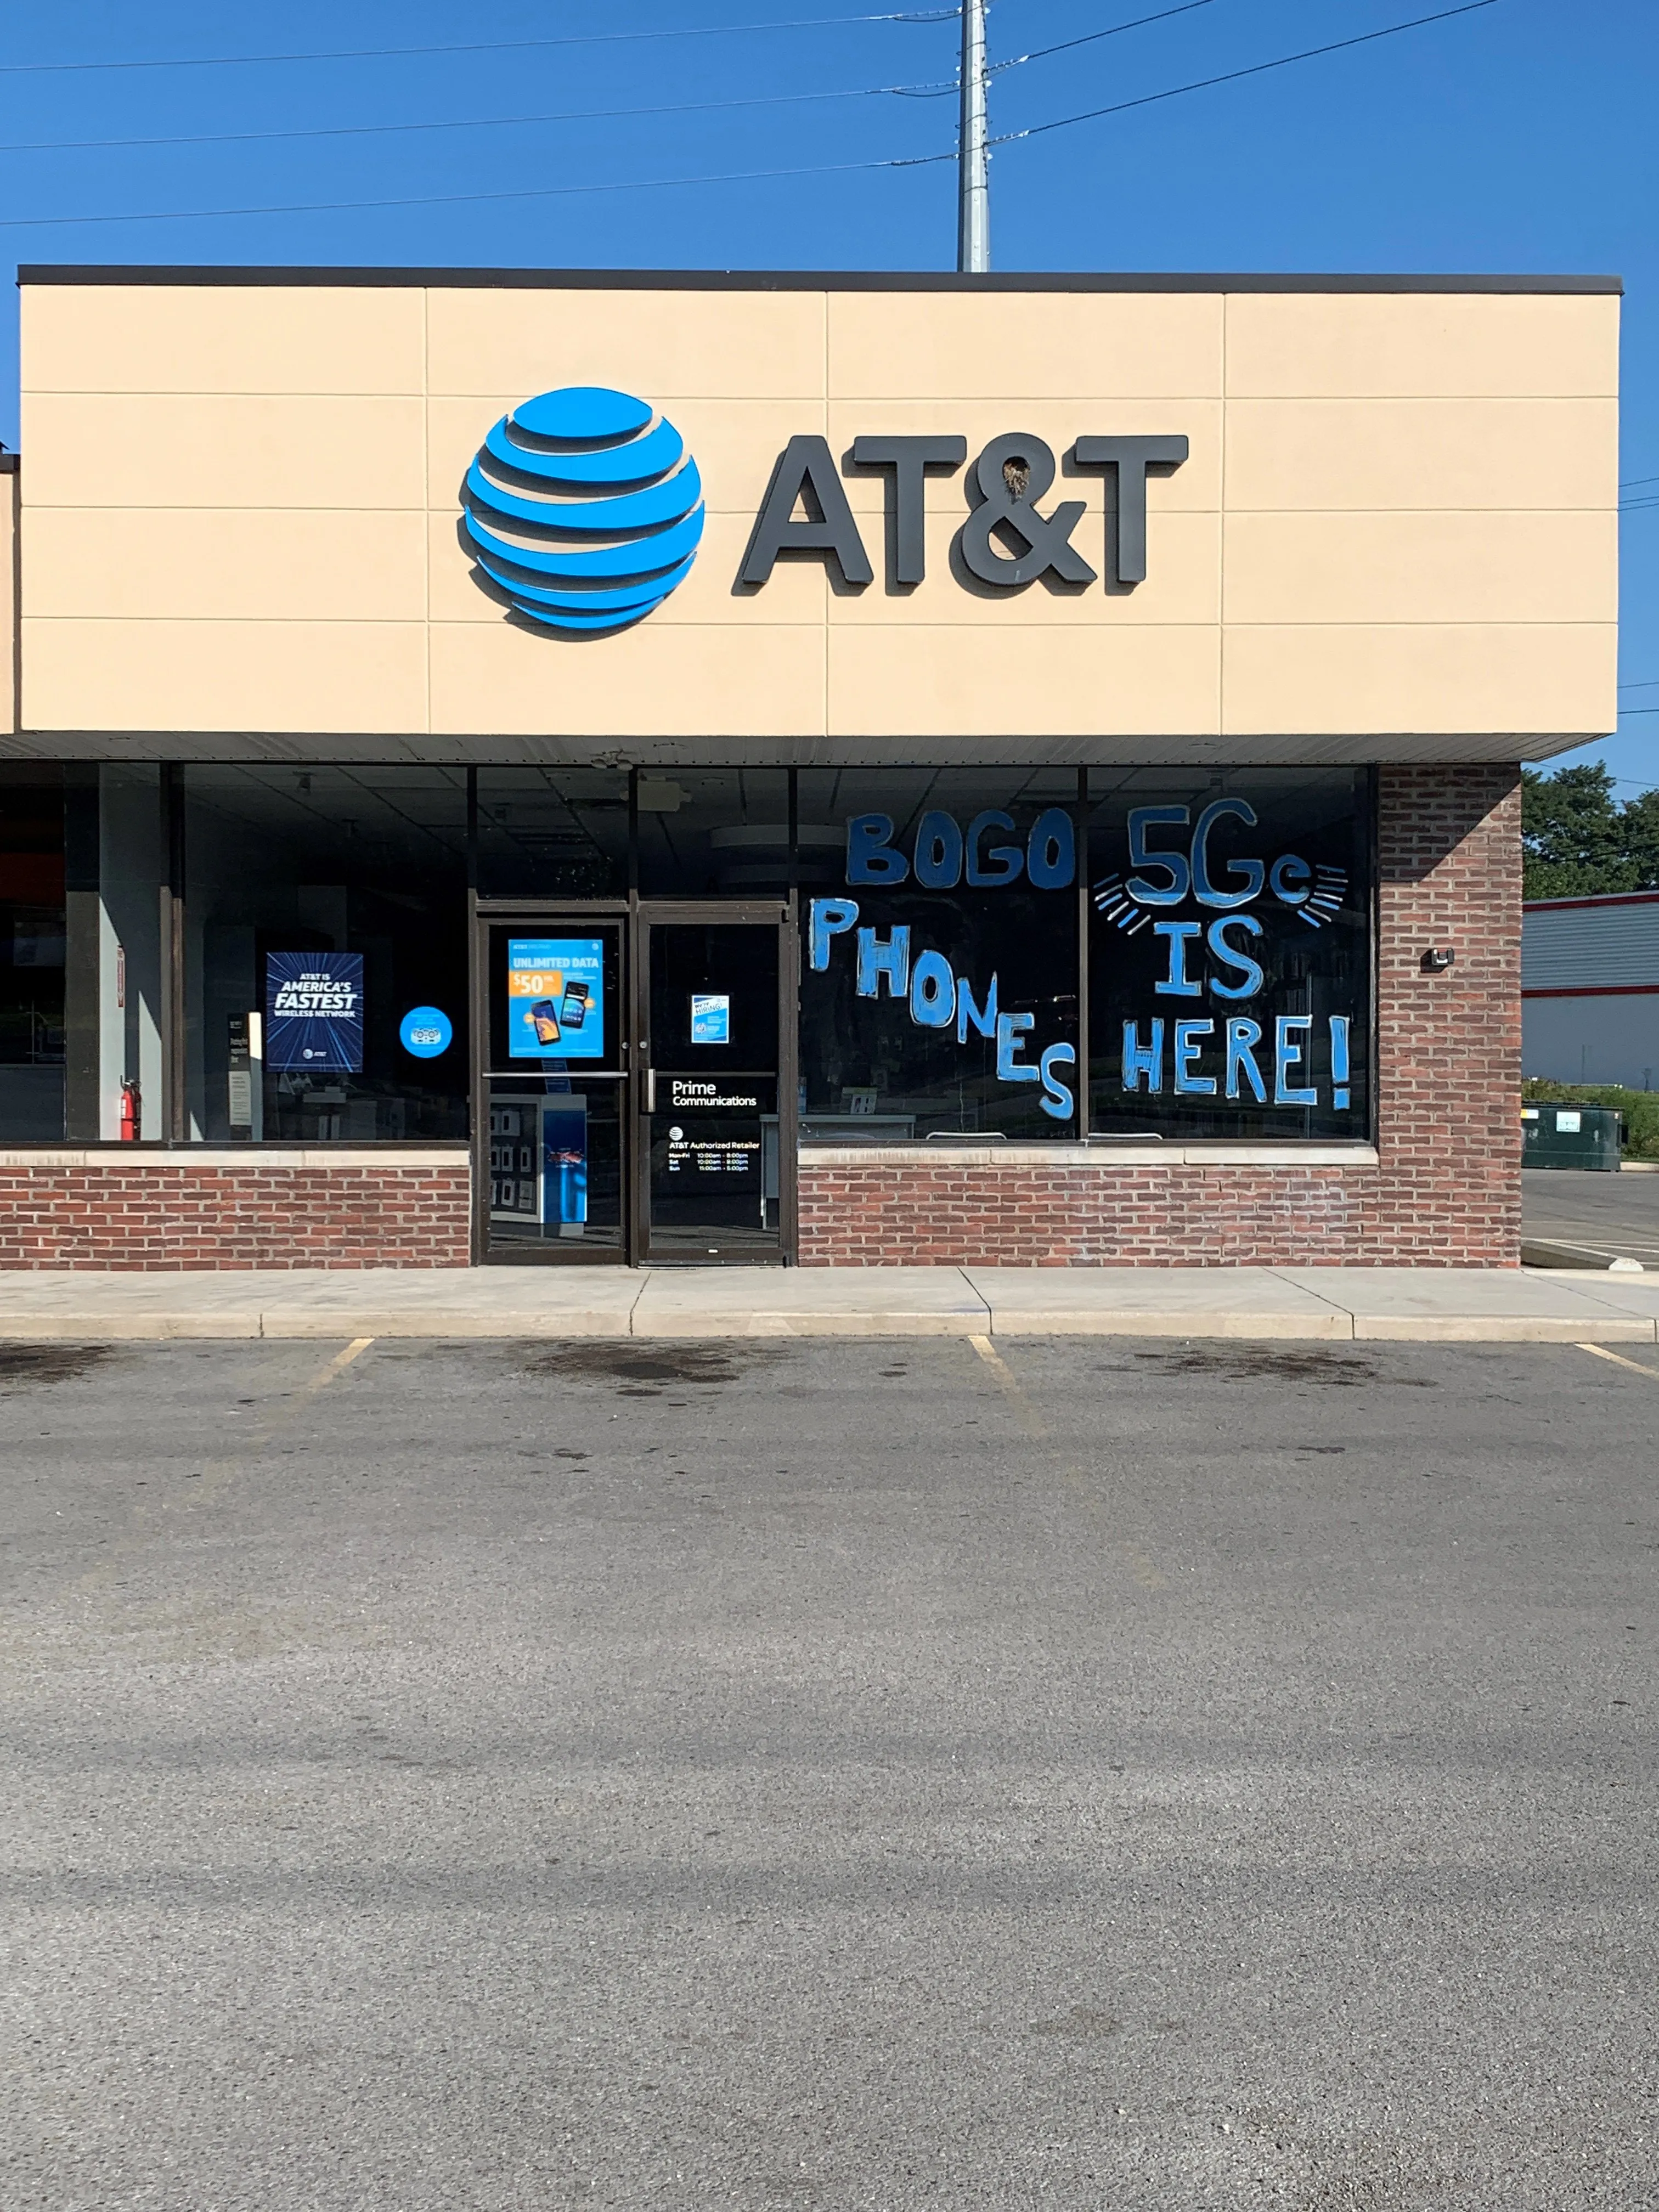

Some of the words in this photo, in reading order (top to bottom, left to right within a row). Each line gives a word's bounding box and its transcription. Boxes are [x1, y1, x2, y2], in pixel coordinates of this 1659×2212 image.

[742, 432, 1188, 585] AT&T
[845, 807, 1076, 889] BOGO
[513, 957, 571, 968] UNLIMITED
[572, 957, 599, 968] DATA
[1154, 915, 1263, 1000] IS
[281, 981, 352, 992] AMERICA'S
[514, 973, 543, 994] $50
[275, 994, 357, 1009] FASTEST
[809, 898, 1075, 1120] PHONES
[1122, 1014, 1351, 1110] HERE!
[673, 1081, 716, 1095] Prime
[673, 1096, 757, 1106] Communications
